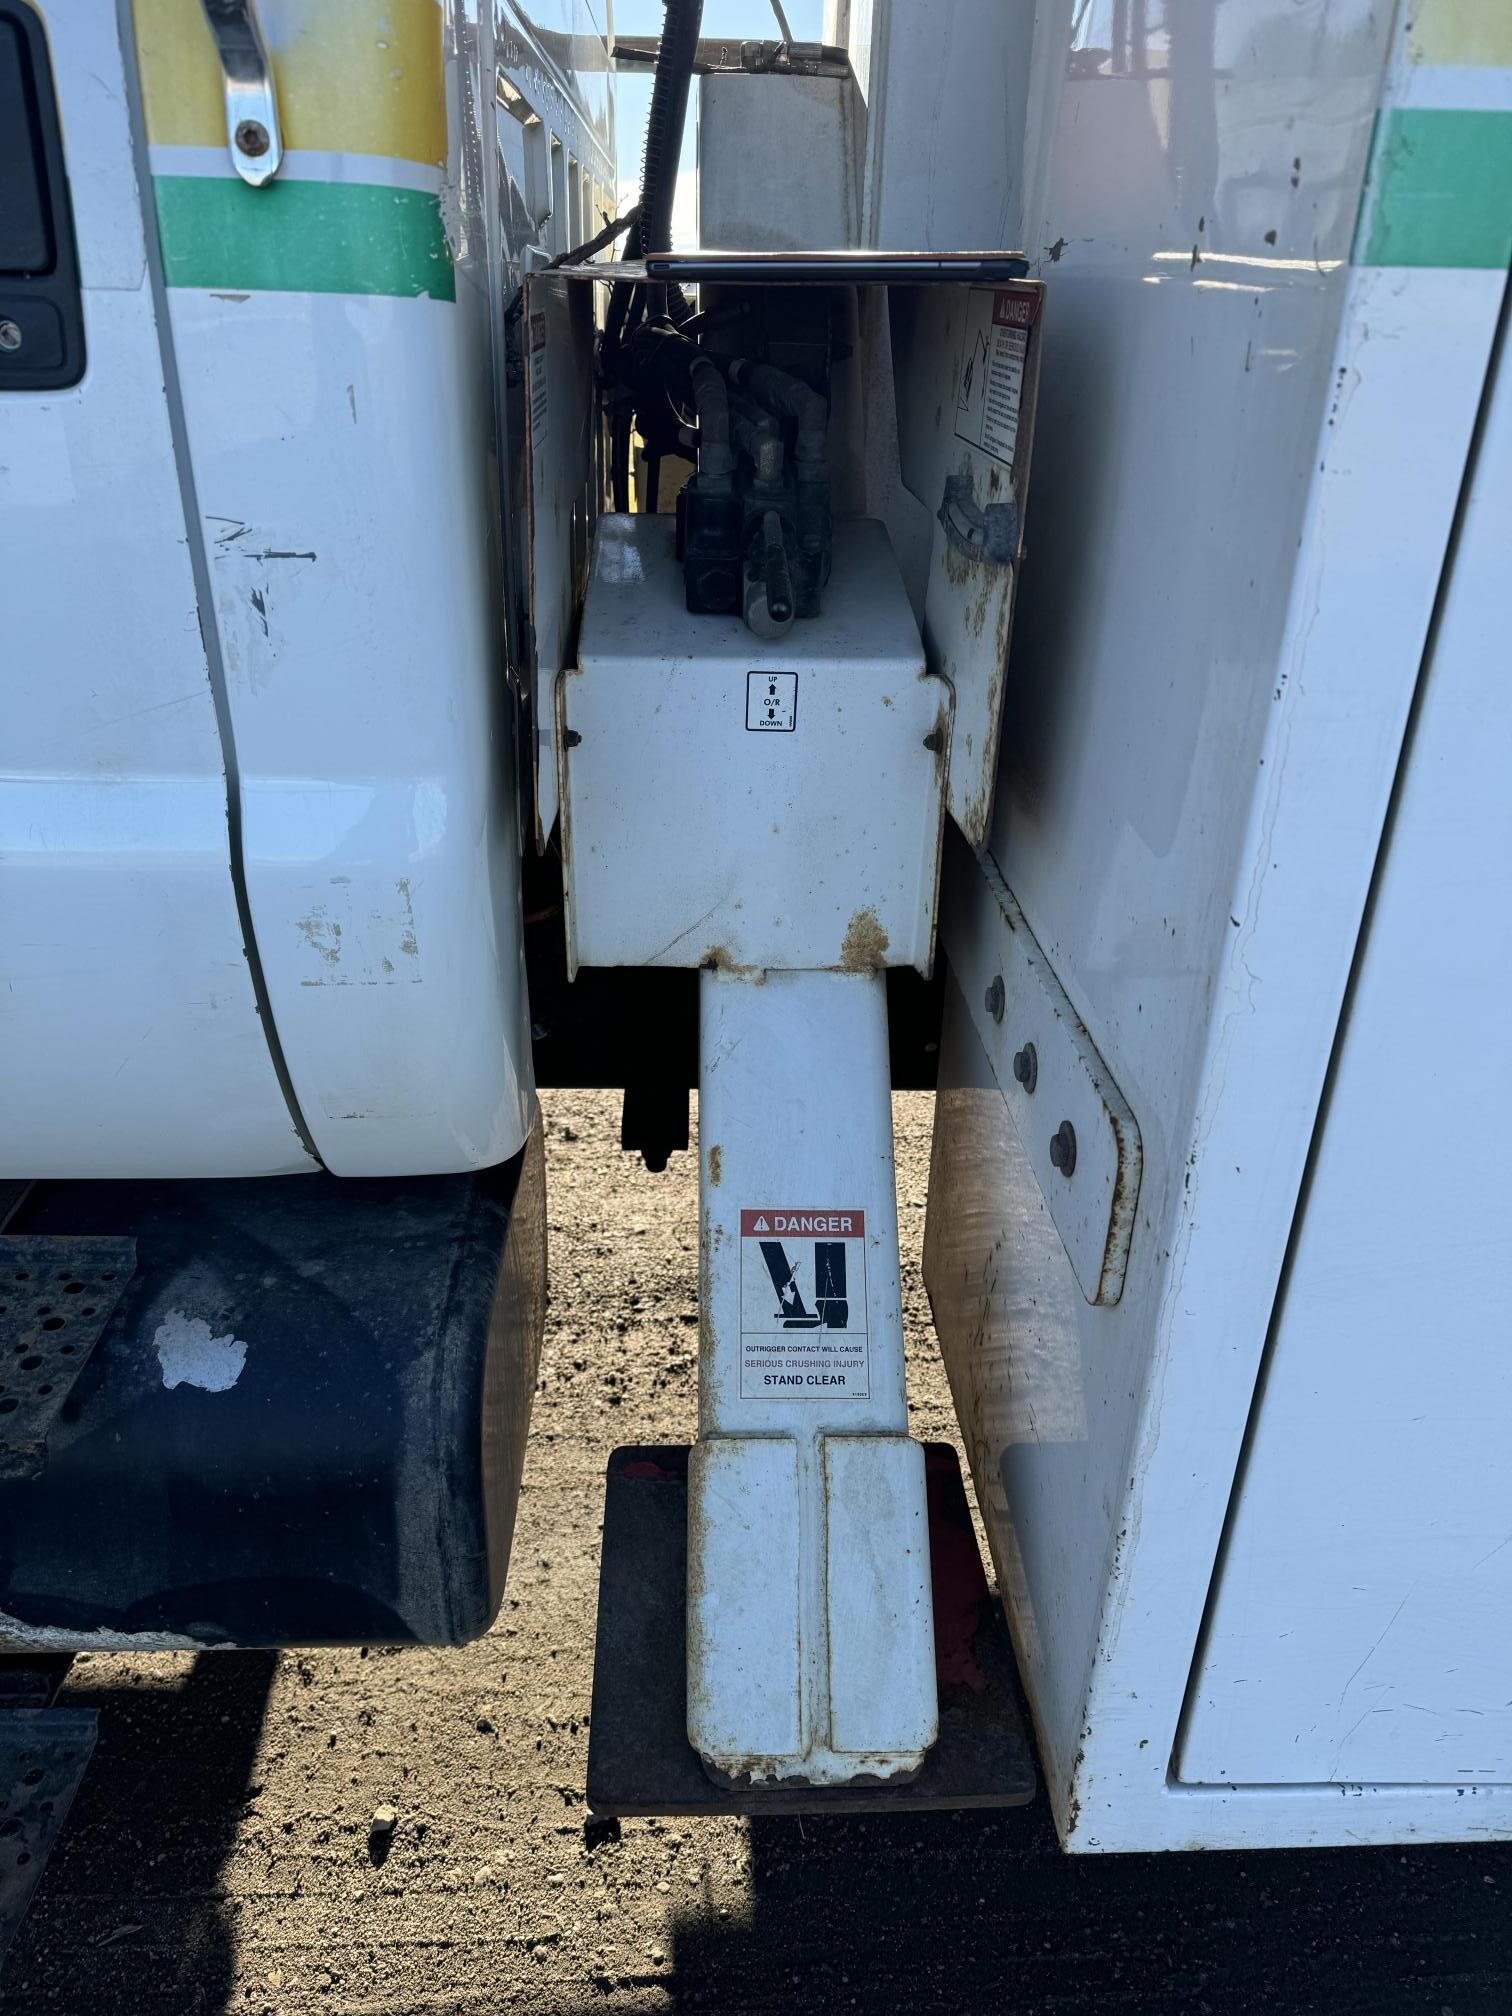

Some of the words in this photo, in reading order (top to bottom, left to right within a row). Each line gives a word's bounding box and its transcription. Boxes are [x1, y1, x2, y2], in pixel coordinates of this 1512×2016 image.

[764, 698, 780, 706] O/R
[774, 1216, 852, 1231] DANGER
[745, 1345, 786, 1353] OUTRIGGER
[744, 1360, 783, 1368] SERIOUS
[785, 1360, 831, 1368] CRUSHING
[833, 1360, 865, 1368] INJURY
[764, 1375, 803, 1385] STAND
[807, 1375, 846, 1385] CLEAR
